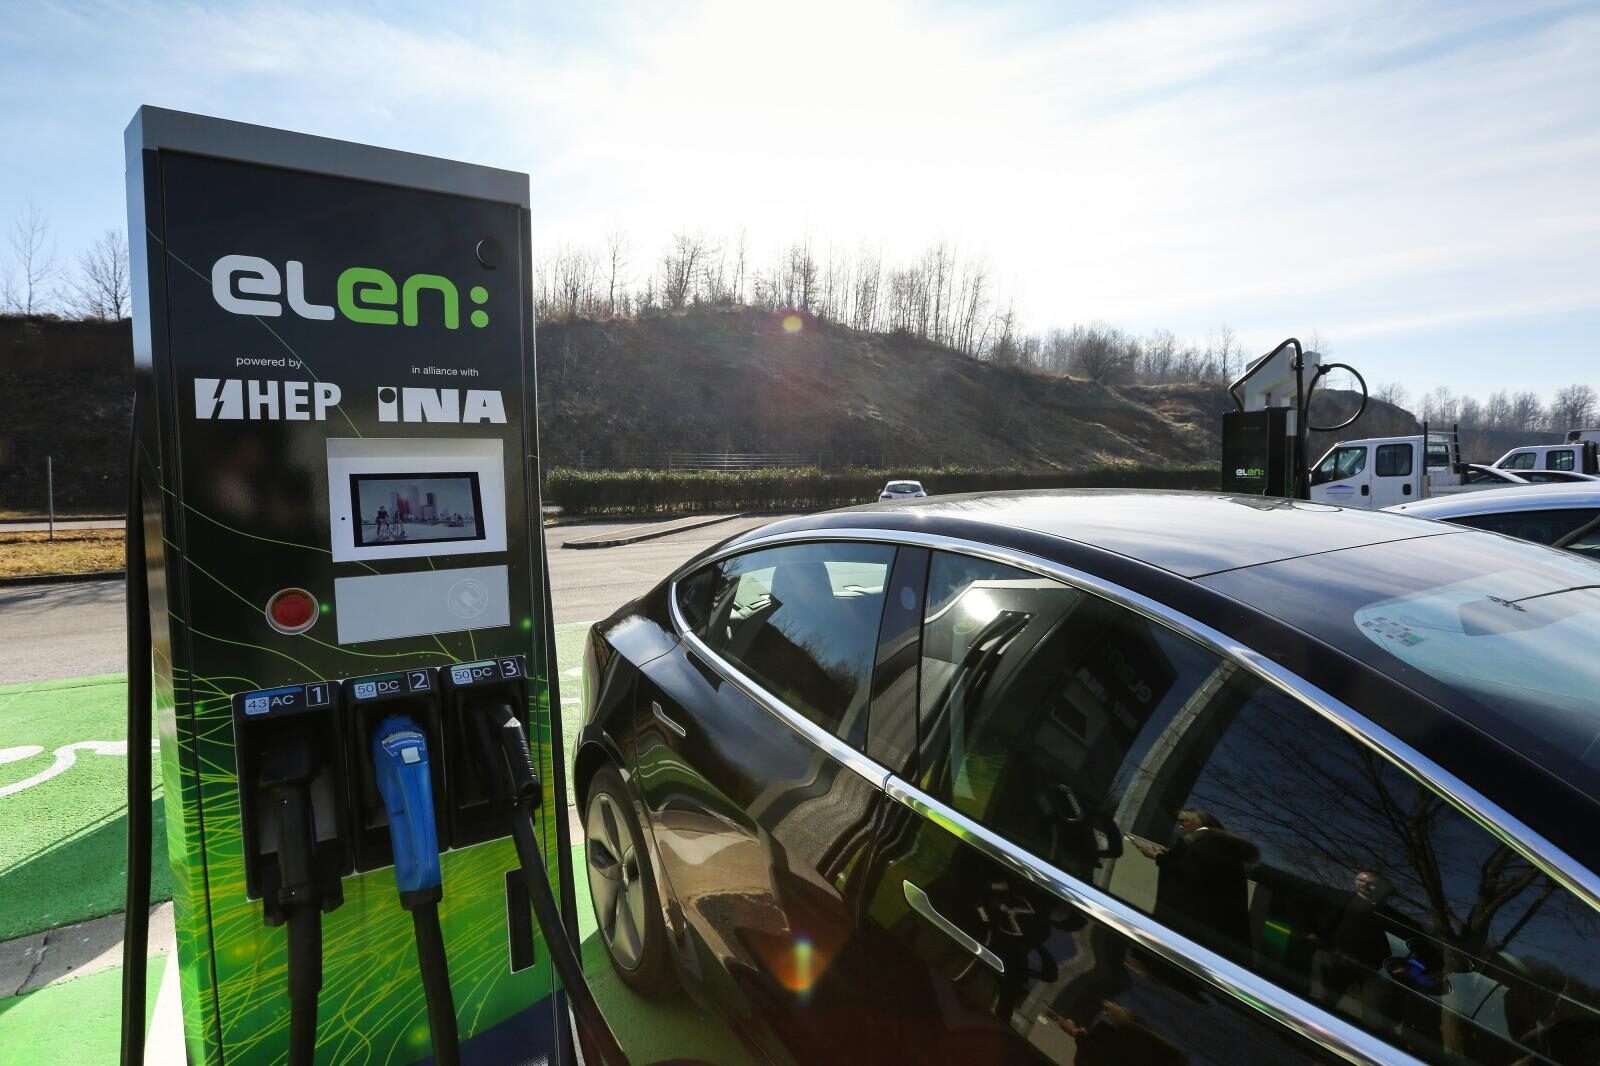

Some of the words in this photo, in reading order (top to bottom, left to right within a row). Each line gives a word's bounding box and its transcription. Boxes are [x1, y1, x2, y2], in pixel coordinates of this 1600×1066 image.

[236, 357, 285, 368] powered
[288, 357, 302, 369] by
[411, 366, 420, 375] in
[422, 366, 458, 376] alliance
[460, 367, 479, 377] with
[248, 380, 341, 421] HEP
[454, 671, 470, 680] 50
[473, 667, 492, 678] DC
[503, 661, 517, 675] 3
[358, 684, 374, 694] 50
[378, 680, 400, 692] DC
[412, 673, 428, 689] 2
[247, 698, 268, 710] 43
[271, 694, 294, 707] AC
[314, 687, 322, 703] 1
